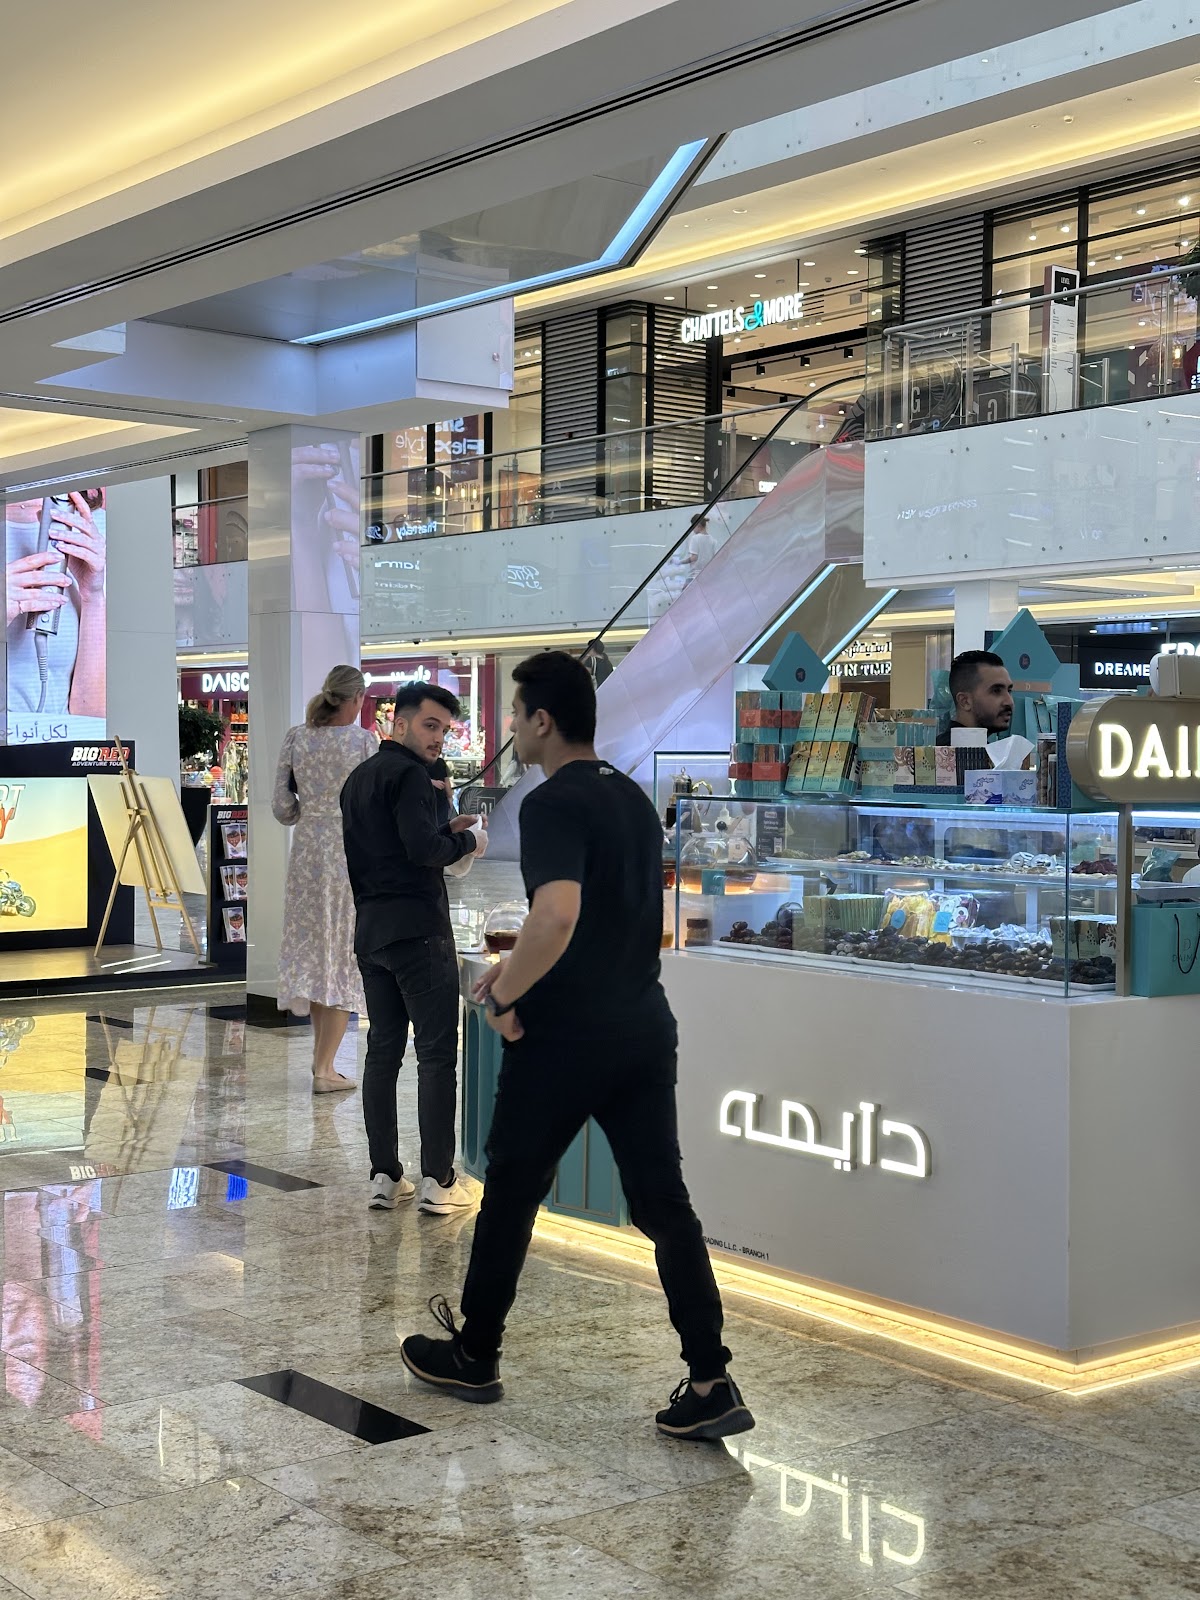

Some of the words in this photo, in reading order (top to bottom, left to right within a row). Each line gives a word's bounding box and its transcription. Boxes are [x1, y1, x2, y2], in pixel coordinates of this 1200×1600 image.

[763, 292, 804, 326] MORE
[1094, 662, 1151, 677] DREAME
[1098, 722, 1200, 778] DAI
[742, 1246, 766, 1259] BRANCH
